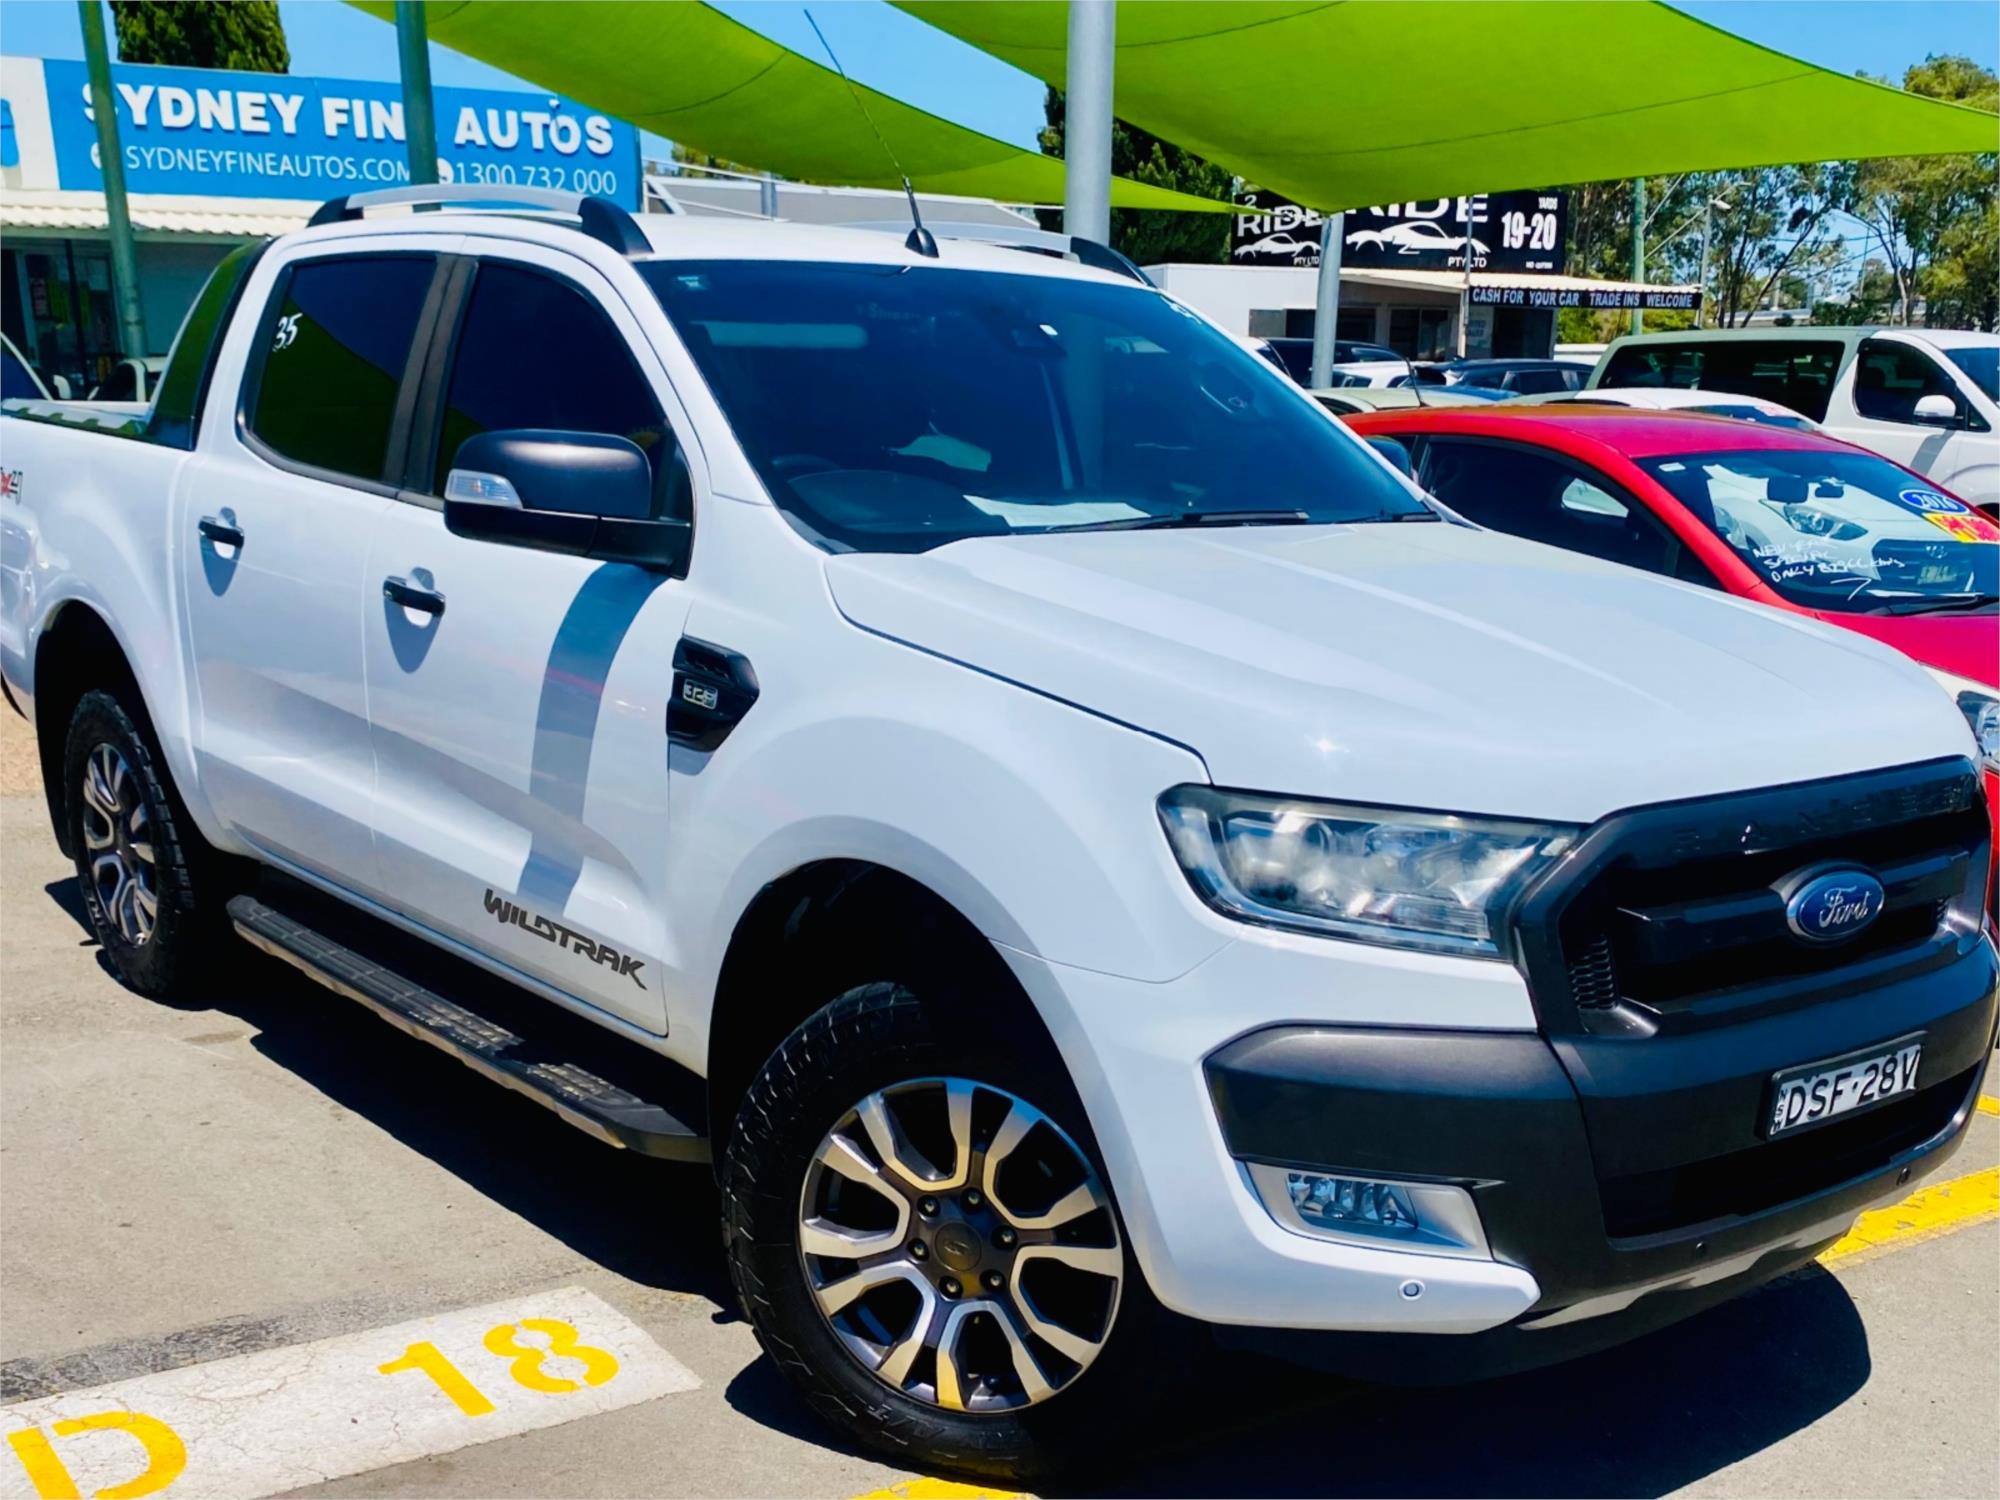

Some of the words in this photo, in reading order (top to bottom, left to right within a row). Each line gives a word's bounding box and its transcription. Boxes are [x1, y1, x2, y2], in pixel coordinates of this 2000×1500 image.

[322, 97, 437, 141] FIN
[454, 107, 614, 155] AUTOS
[126, 146, 411, 181] SYDNEYFINEAUTOS.COM
[456, 162, 516, 185] 1300
[523, 166, 565, 190] 732
[574, 169, 617, 195] 000
[1501, 211, 1557, 250] 19-20
[1293, 256, 1306, 266] PTY
[1307, 255, 1320, 265] LTD
[1448, 256, 1466, 268] PTY
[1472, 288, 1500, 304] CASH
[1503, 290, 1524, 304] FOR
[1529, 290, 1557, 307] YOUR
[1559, 292, 1580, 306] CAR
[1590, 292, 1621, 307] TRADE
[1623, 293, 1640, 307] INS
[1647, 294, 1693, 308] WELCOME
[274, 313, 303, 350] 35
[1819, 885, 1870, 929] Ford
[484, 888, 648, 991] WILDTRAK
[376, 1317, 620, 1417] 18
